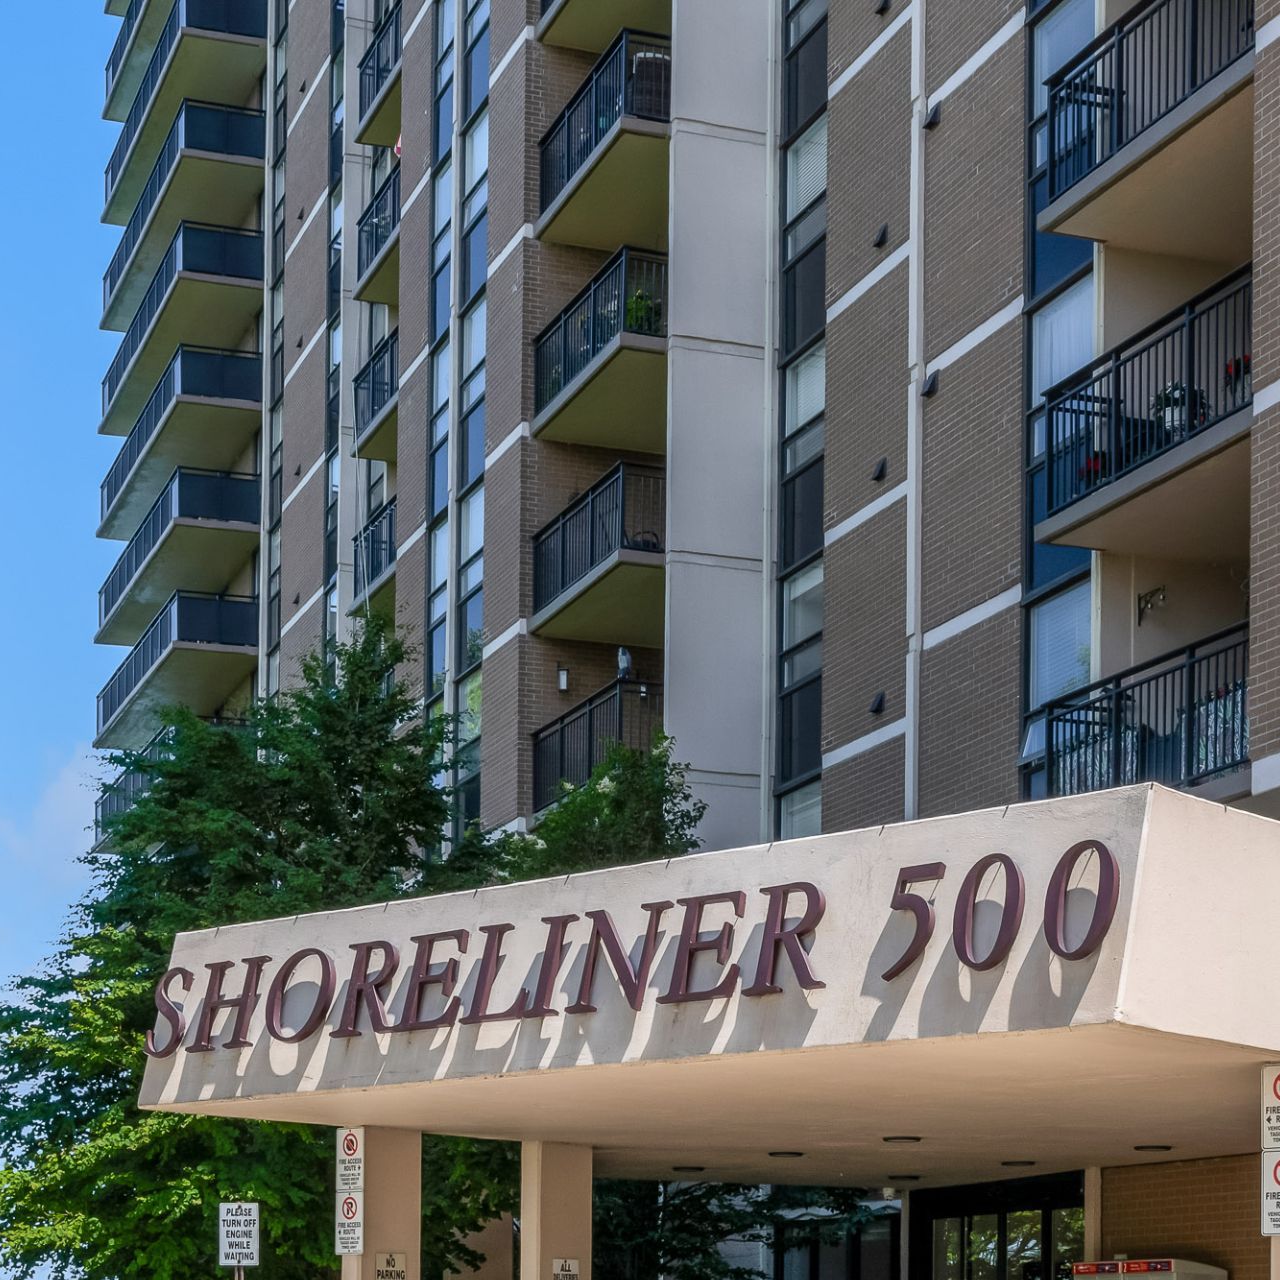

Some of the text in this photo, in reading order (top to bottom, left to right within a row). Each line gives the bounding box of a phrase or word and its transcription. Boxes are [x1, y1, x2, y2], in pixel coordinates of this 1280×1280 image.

[144, 838, 1122, 1059] SHORELINER 500
[1266, 1106, 1280, 1114] FIRE
[1266, 1192, 1280, 1200] FIRE
[226, 1208, 252, 1216] PLEASE
[222, 1219, 256, 1227] TURN OFF
[228, 1241, 250, 1249] WHILE
[224, 1252, 254, 1260] WAITING
[386, 1258, 395, 1268] NO
[560, 1264, 571, 1272] ALL
[377, 1270, 405, 1280] PARKING
